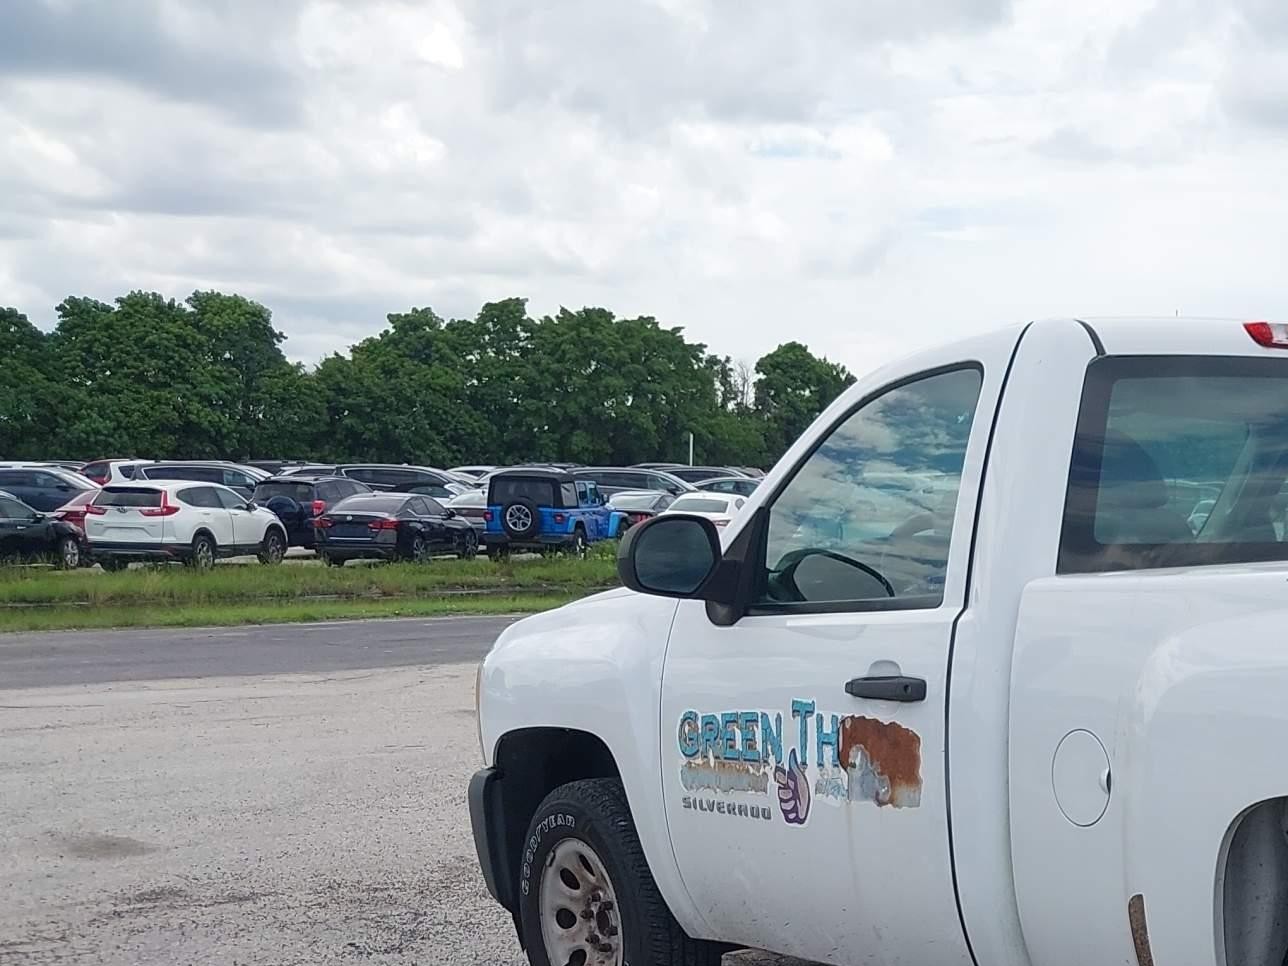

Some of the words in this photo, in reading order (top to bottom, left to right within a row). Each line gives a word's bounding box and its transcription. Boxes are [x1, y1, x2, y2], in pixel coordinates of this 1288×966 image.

[677, 709, 783, 765] GREEN
[681, 796, 773, 821] SILVERADO
[521, 813, 576, 896] GOODYEAR
